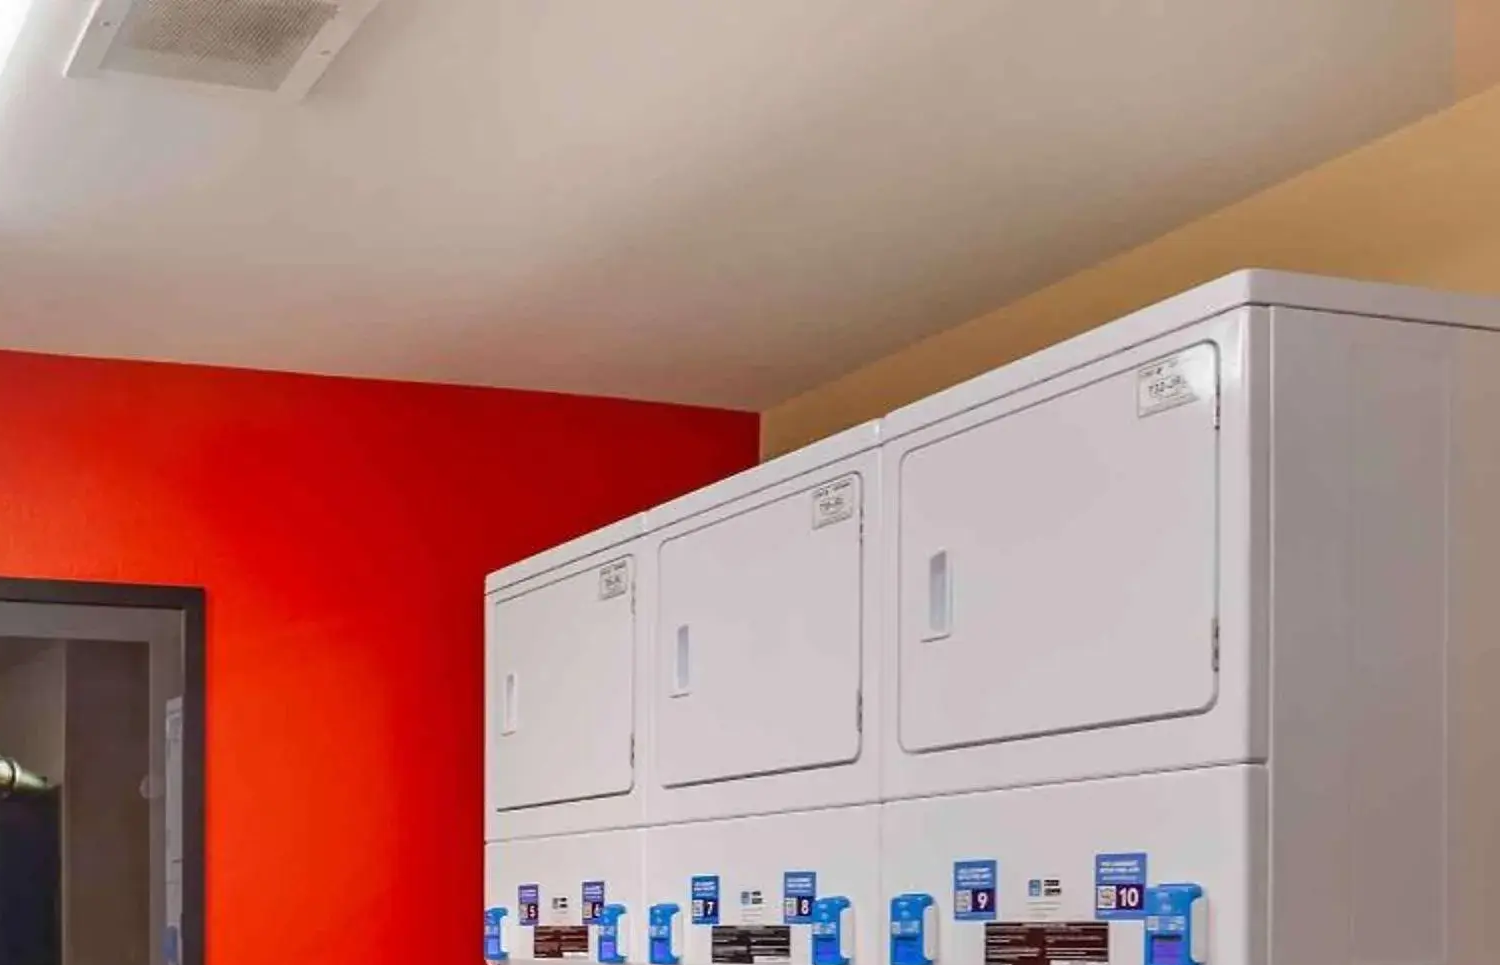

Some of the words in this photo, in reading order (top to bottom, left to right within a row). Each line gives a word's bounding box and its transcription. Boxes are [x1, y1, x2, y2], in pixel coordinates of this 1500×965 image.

[977, 892, 988, 909] 9
[1119, 887, 1140, 907] 10
[707, 900, 715, 916] 7
[801, 899, 810, 915] 8
